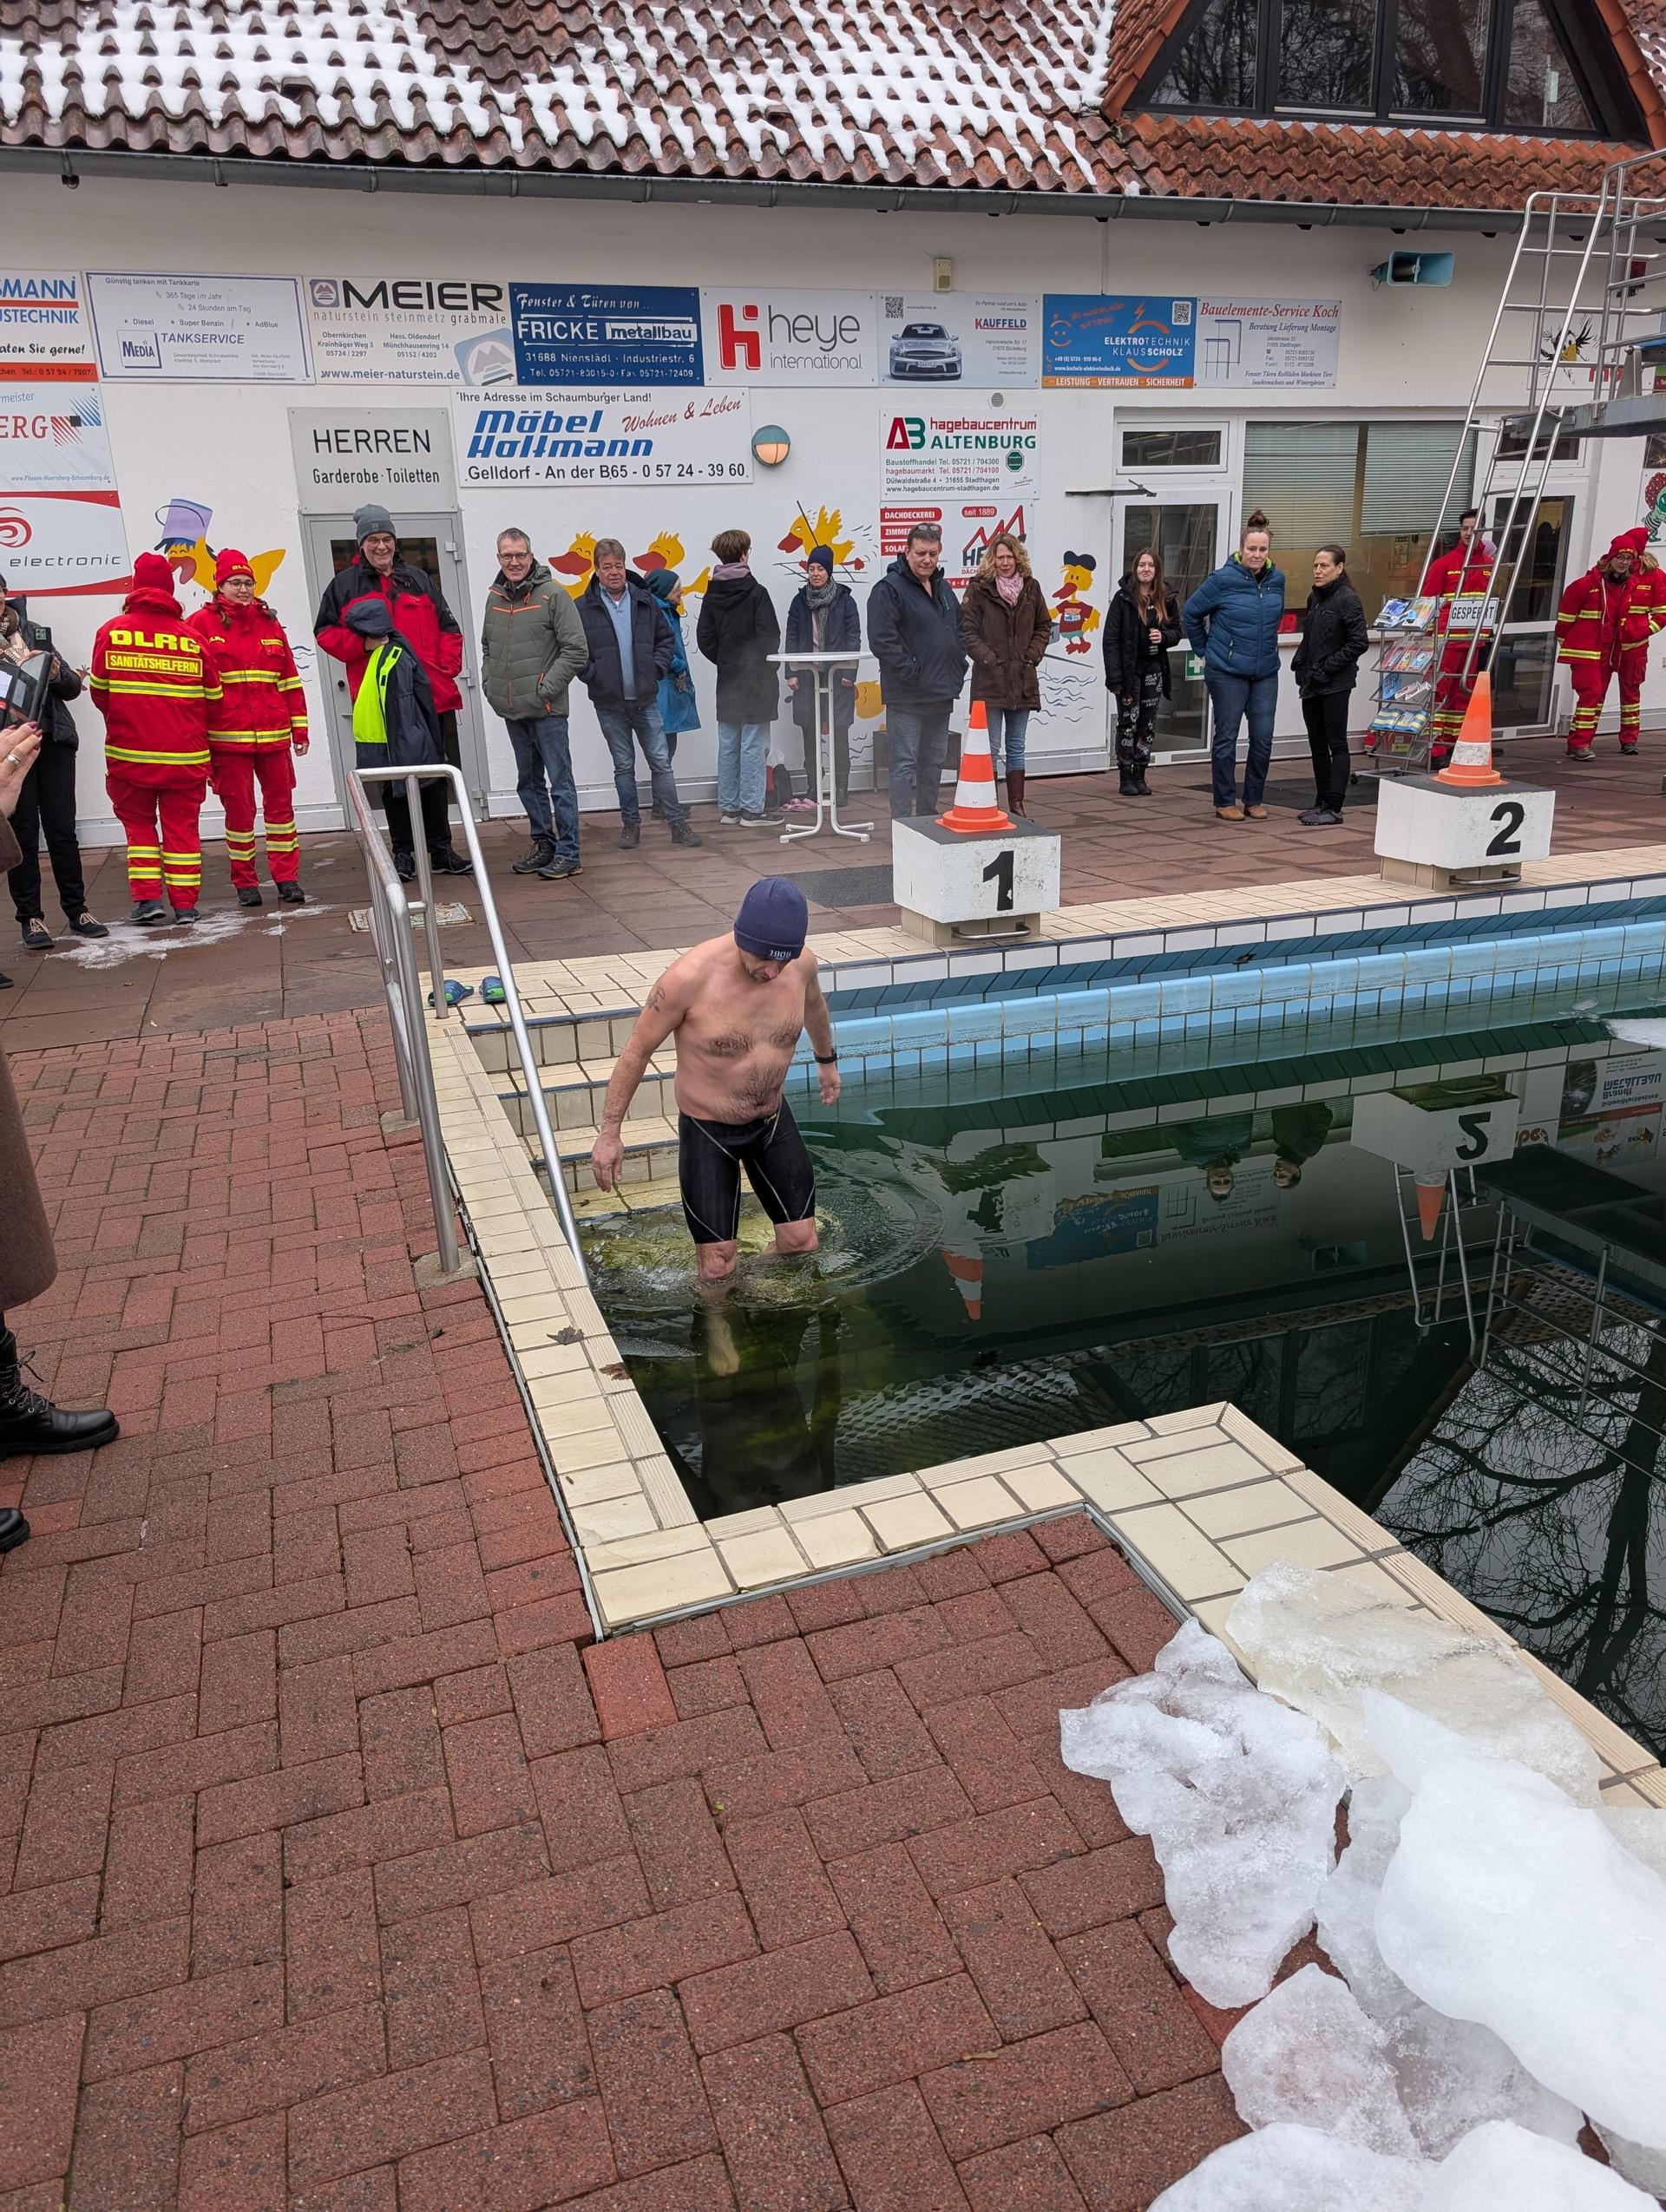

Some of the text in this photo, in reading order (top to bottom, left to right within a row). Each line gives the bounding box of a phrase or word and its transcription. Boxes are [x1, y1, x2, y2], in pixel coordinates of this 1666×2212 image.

[0, 278, 75, 298] MANN
[343, 280, 504, 311] MEIER
[517, 293, 640, 309] Fenster & Türen von
[0, 310, 79, 324] STECHNIK
[314, 311, 506, 325] naturstein steinmetz grabmale
[1200, 303, 1338, 318] Bauelemente-Service Koch
[517, 321, 692, 340] FRICKE metallbau
[769, 305, 860, 352] heye
[975, 318, 1026, 329] KAUFFELD
[1250, 323, 1336, 333] Beratung Lieferung Montage
[161, 333, 245, 344] TANKSERVICE
[1105, 337, 1190, 346] ELEKTROTECHNIK
[30, 344, 45, 353] Sie
[49, 344, 85, 357] gerne!
[623, 354, 685, 363] Industriestr.
[771, 353, 863, 369] international
[321, 369, 460, 380] www.meier-naturstein.de
[460, 392, 652, 404] Ihre Adresse im Schaumburger Land!
[475, 410, 603, 433] Möbel
[622, 396, 742, 433] Wohnen & Leben
[886, 416, 1036, 449] AB hagebaucentrum
[313, 429, 430, 453] HERREN
[930, 435, 1036, 449] ALTENBURG
[312, 468, 440, 483] Garderobe Toiletten
[468, 466, 530, 480] Gelldorf
[545, 466, 566, 479] An
[570, 466, 594, 478] der
[600, 465, 627, 478] B65
[643, 465, 650, 477] 0
[656, 464, 672, 477] 57
[677, 464, 694, 477] 24
[708, 463, 724, 476] 39
[10, 553, 121, 567] electronic
[109, 631, 200, 653] DLRG
[110, 654, 198, 674] SANITÄTSHELFERIN
[1486, 802, 1525, 856] 2
[983, 850, 1013, 911] 1
